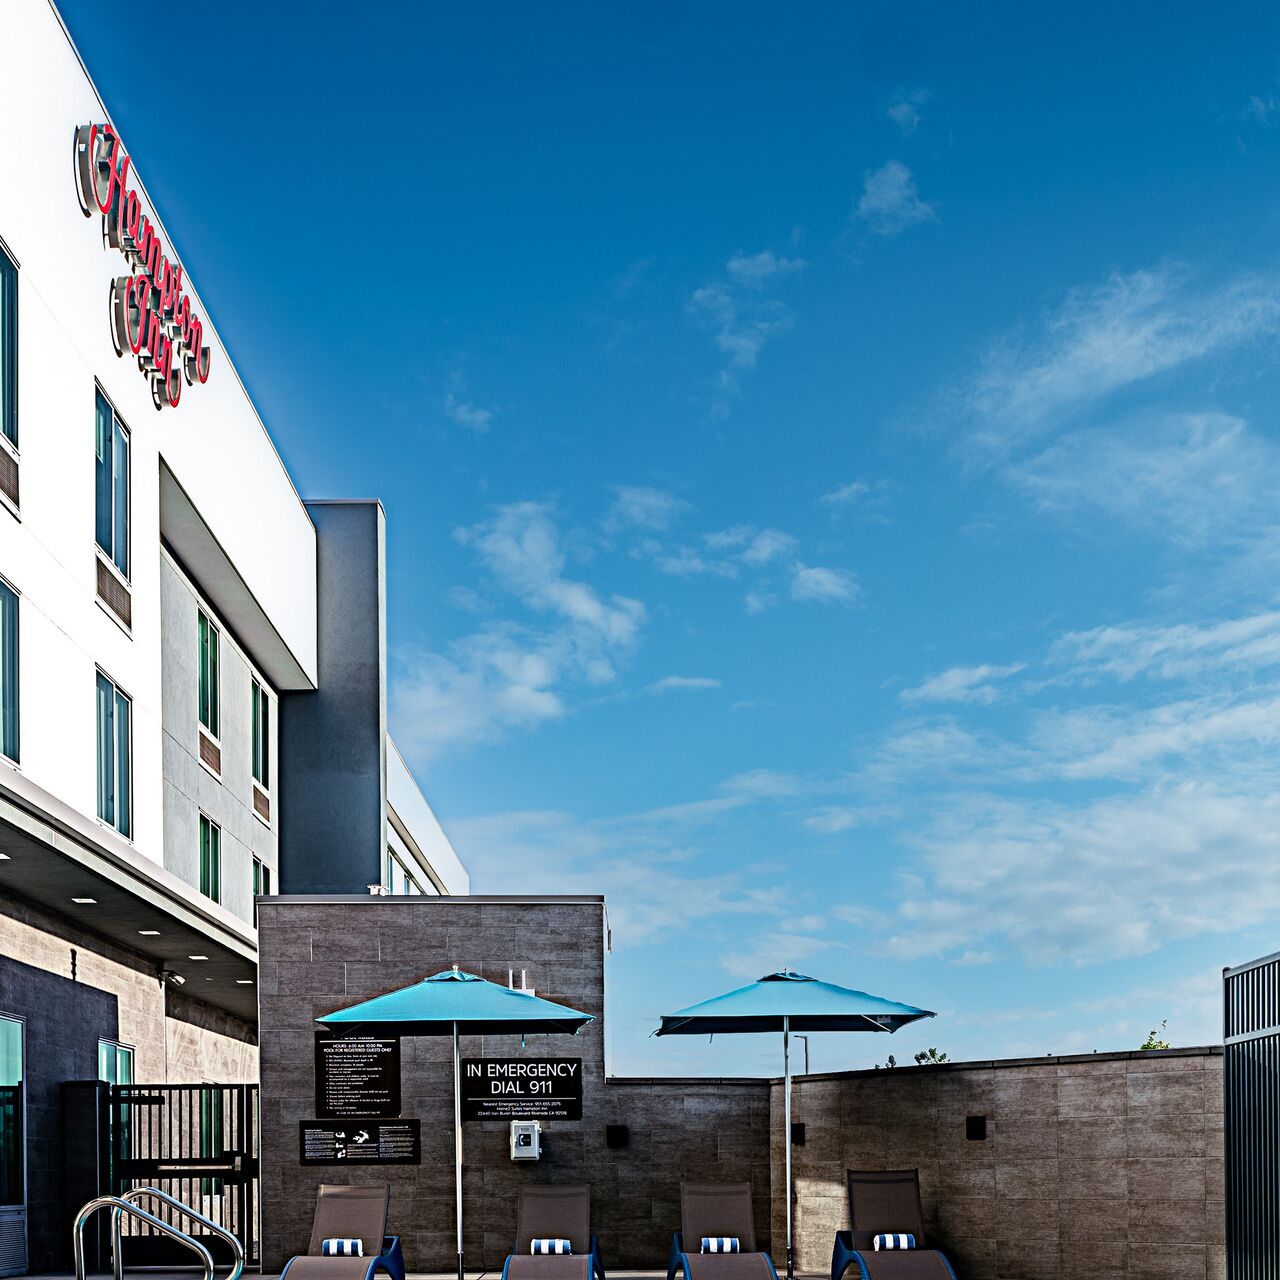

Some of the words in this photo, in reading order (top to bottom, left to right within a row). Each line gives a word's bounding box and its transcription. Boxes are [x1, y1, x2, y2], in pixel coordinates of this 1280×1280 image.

[75, 122, 210, 385] Hampton
[109, 274, 181, 411] Inn
[467, 1064, 482, 1077] IN
[487, 1063, 577, 1077] EMERGENCY
[491, 1081, 525, 1094] DIAL
[529, 1080, 552, 1094] 911
